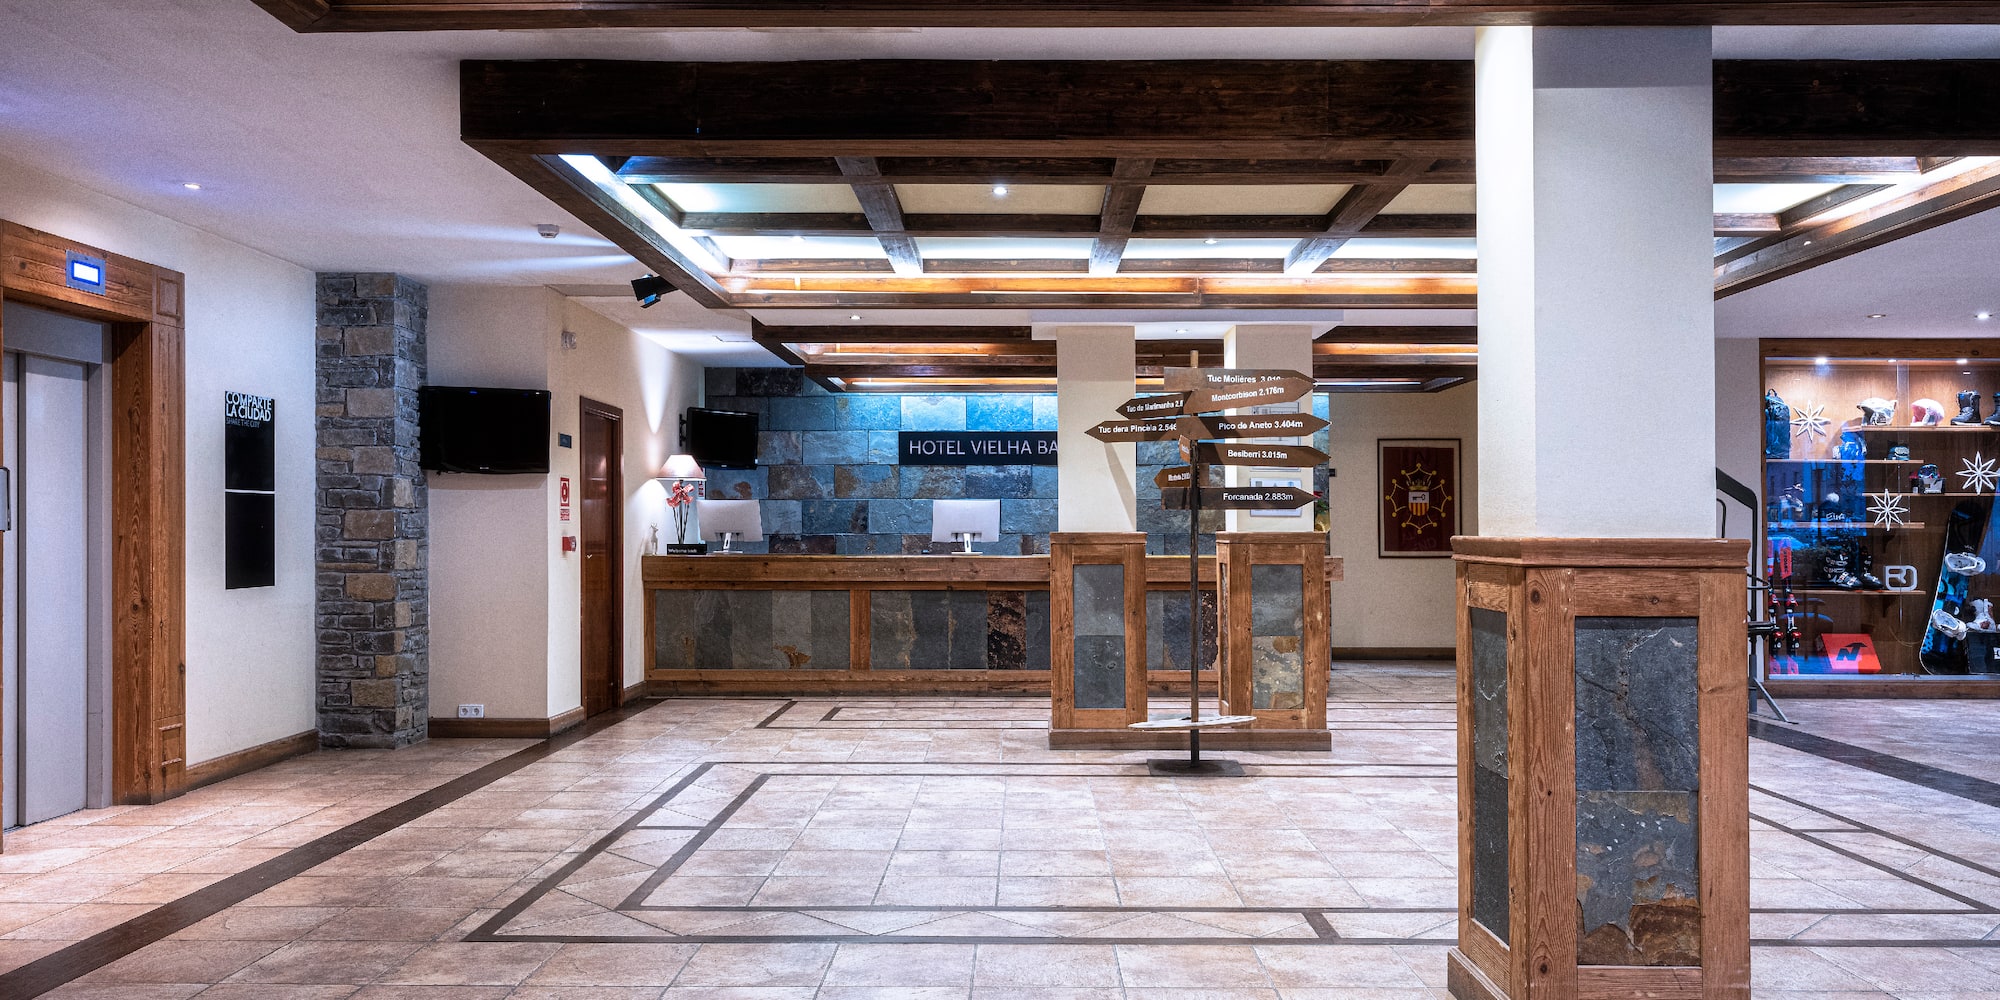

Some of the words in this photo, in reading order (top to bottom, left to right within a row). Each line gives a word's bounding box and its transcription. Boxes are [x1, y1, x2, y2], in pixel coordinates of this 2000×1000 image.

[1207, 374, 1222, 383] Tuc
[1211, 390, 1258, 402] Montcorbison
[1258, 386, 1284, 397] 2.176m
[226, 392, 272, 410] COMPARTE
[226, 403, 237, 417] LA
[238, 406, 271, 421] CIUDAD
[226, 417, 240, 425] SHARE
[1218, 422, 1236, 430] Pico
[1237, 421, 1248, 430] de
[1248, 421, 1273, 429] Aneto
[1273, 420, 1303, 429] 3.404m
[1098, 426, 1112, 434] Tuc
[1112, 425, 1129, 433] dera
[909, 440, 966, 455] HOTEL
[970, 440, 1032, 455] VIELHA
[1037, 440, 1058, 455] BA
[1227, 449, 1261, 458] Besiberri
[1261, 450, 1288, 459] 3.015m
[1223, 492, 1263, 501] Forcanada
[1264, 492, 1294, 501] 2.883m
